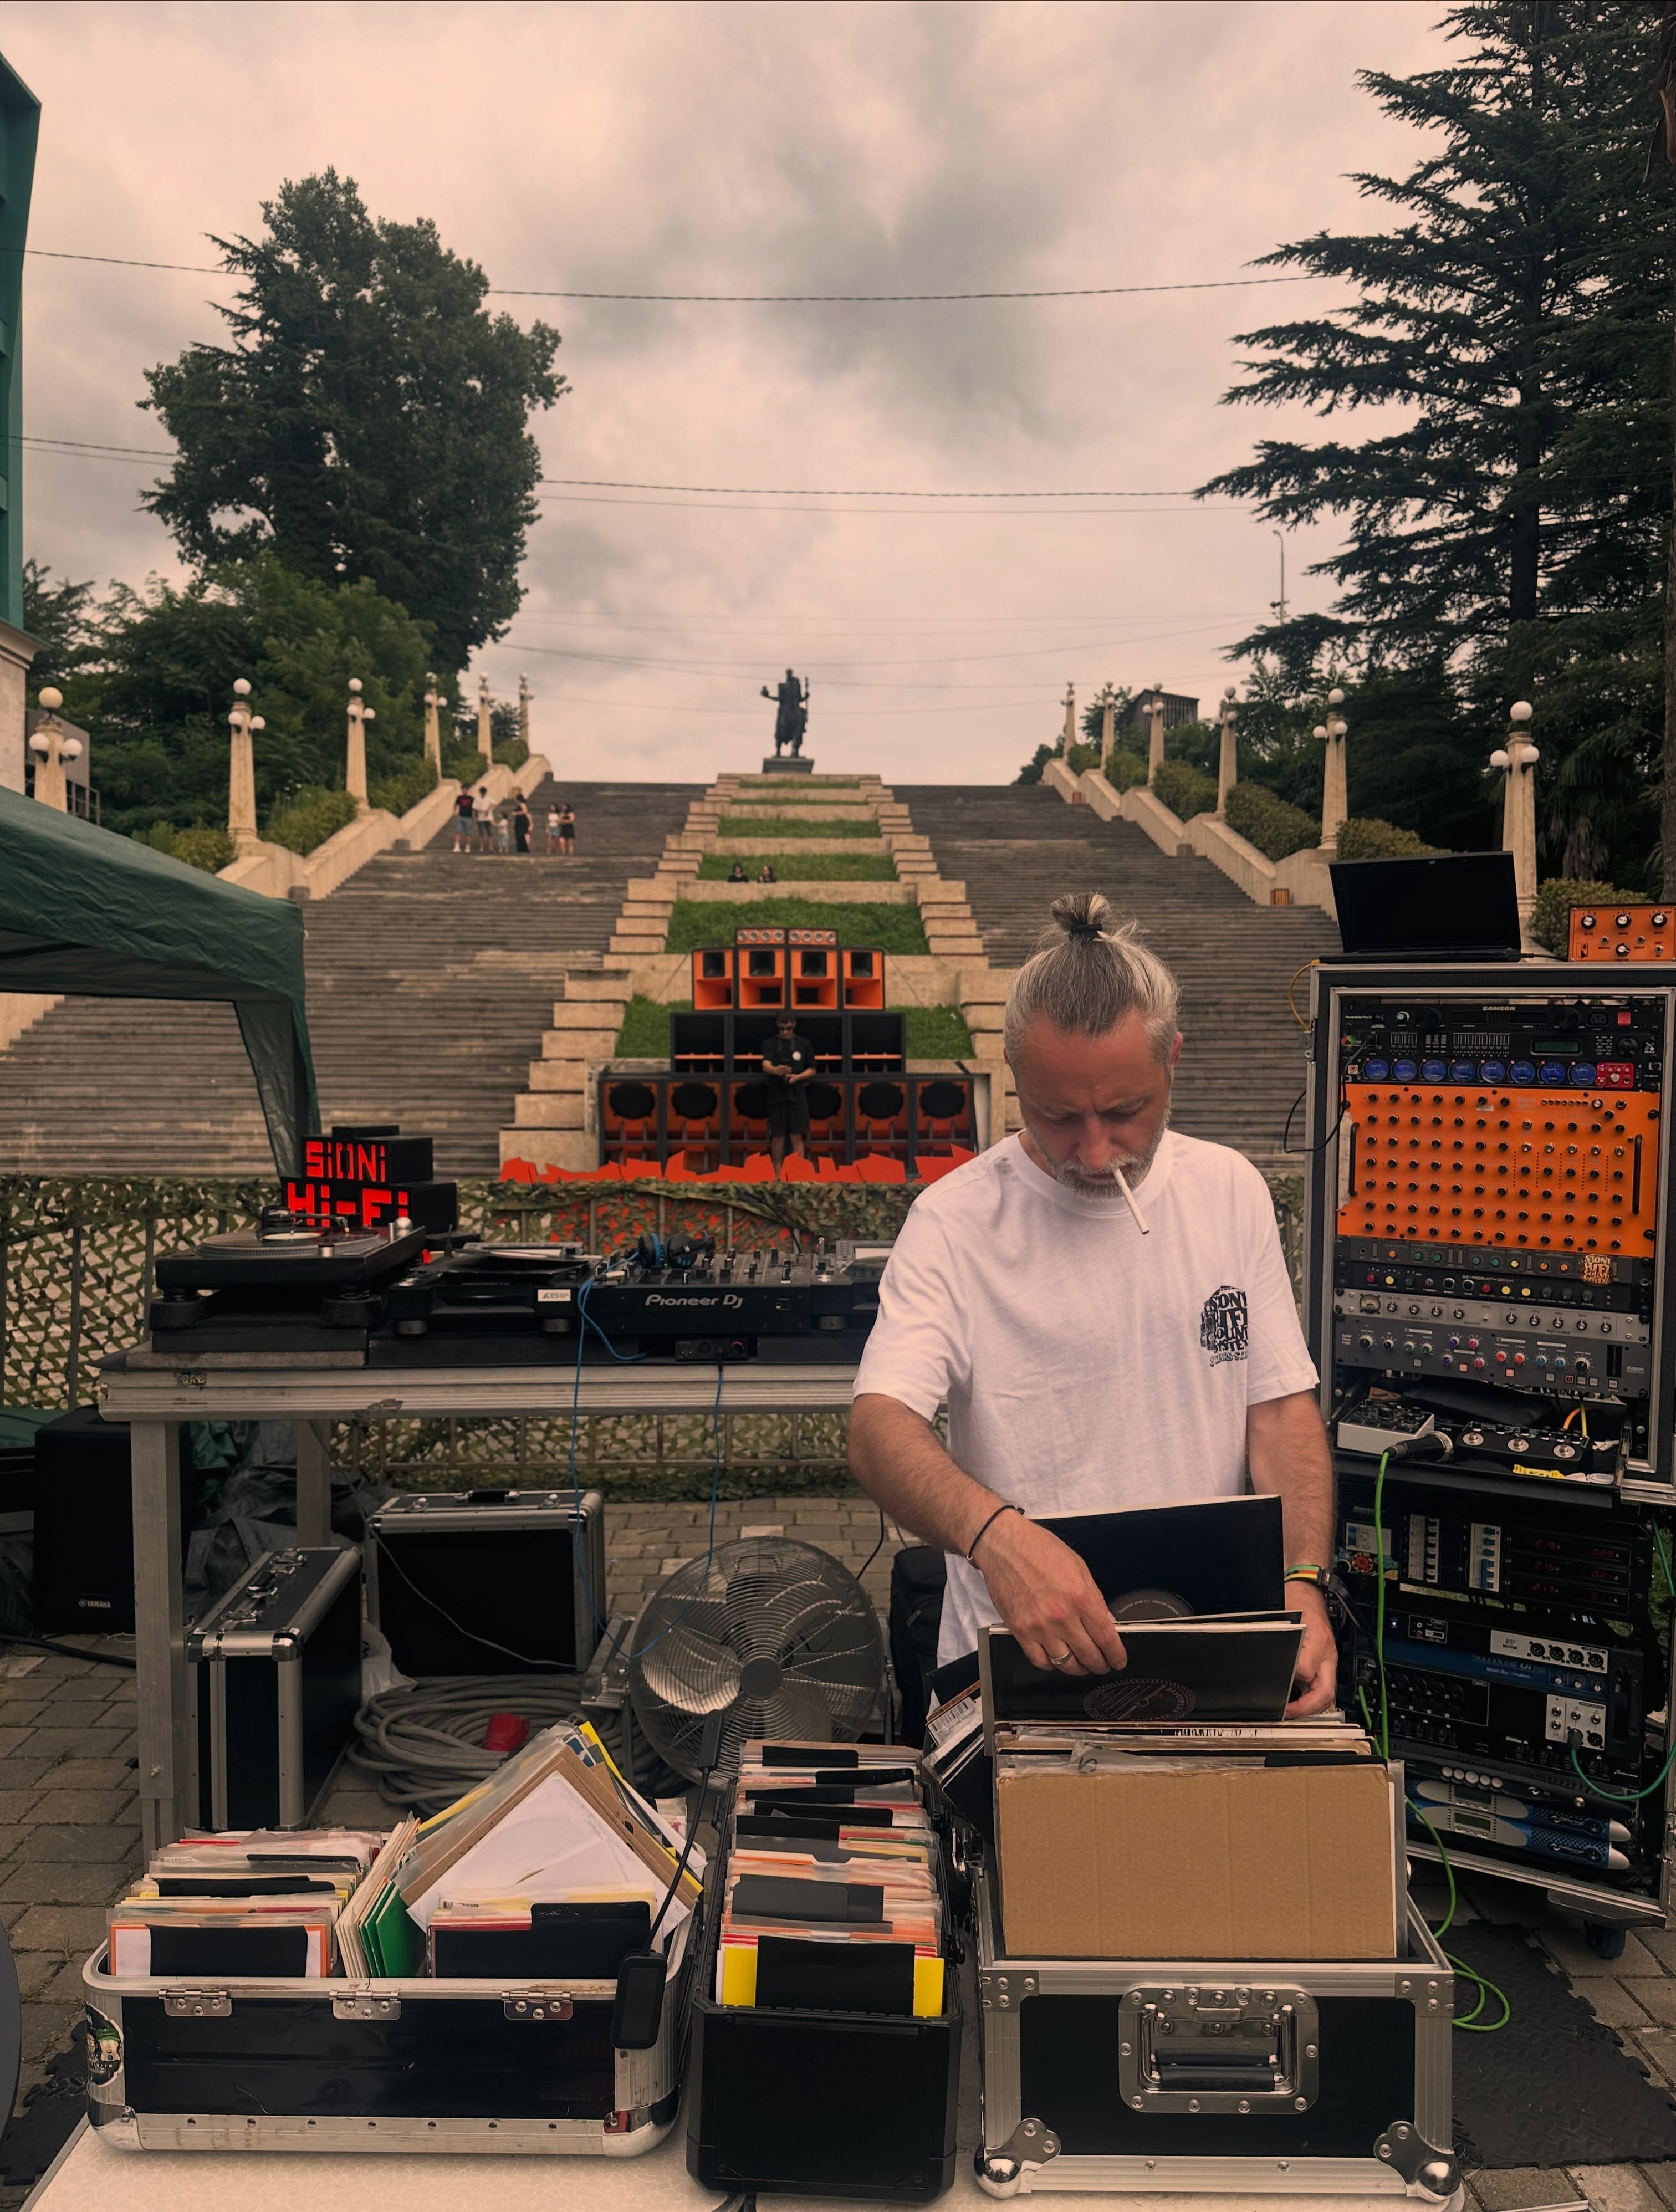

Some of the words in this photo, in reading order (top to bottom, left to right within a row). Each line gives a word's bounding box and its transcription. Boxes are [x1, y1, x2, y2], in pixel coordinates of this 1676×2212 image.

[1584, 1255, 1611, 1265] SIONI
[644, 1293, 717, 1307] Pioneer
[87, 1599, 111, 1608] YAMAHA
